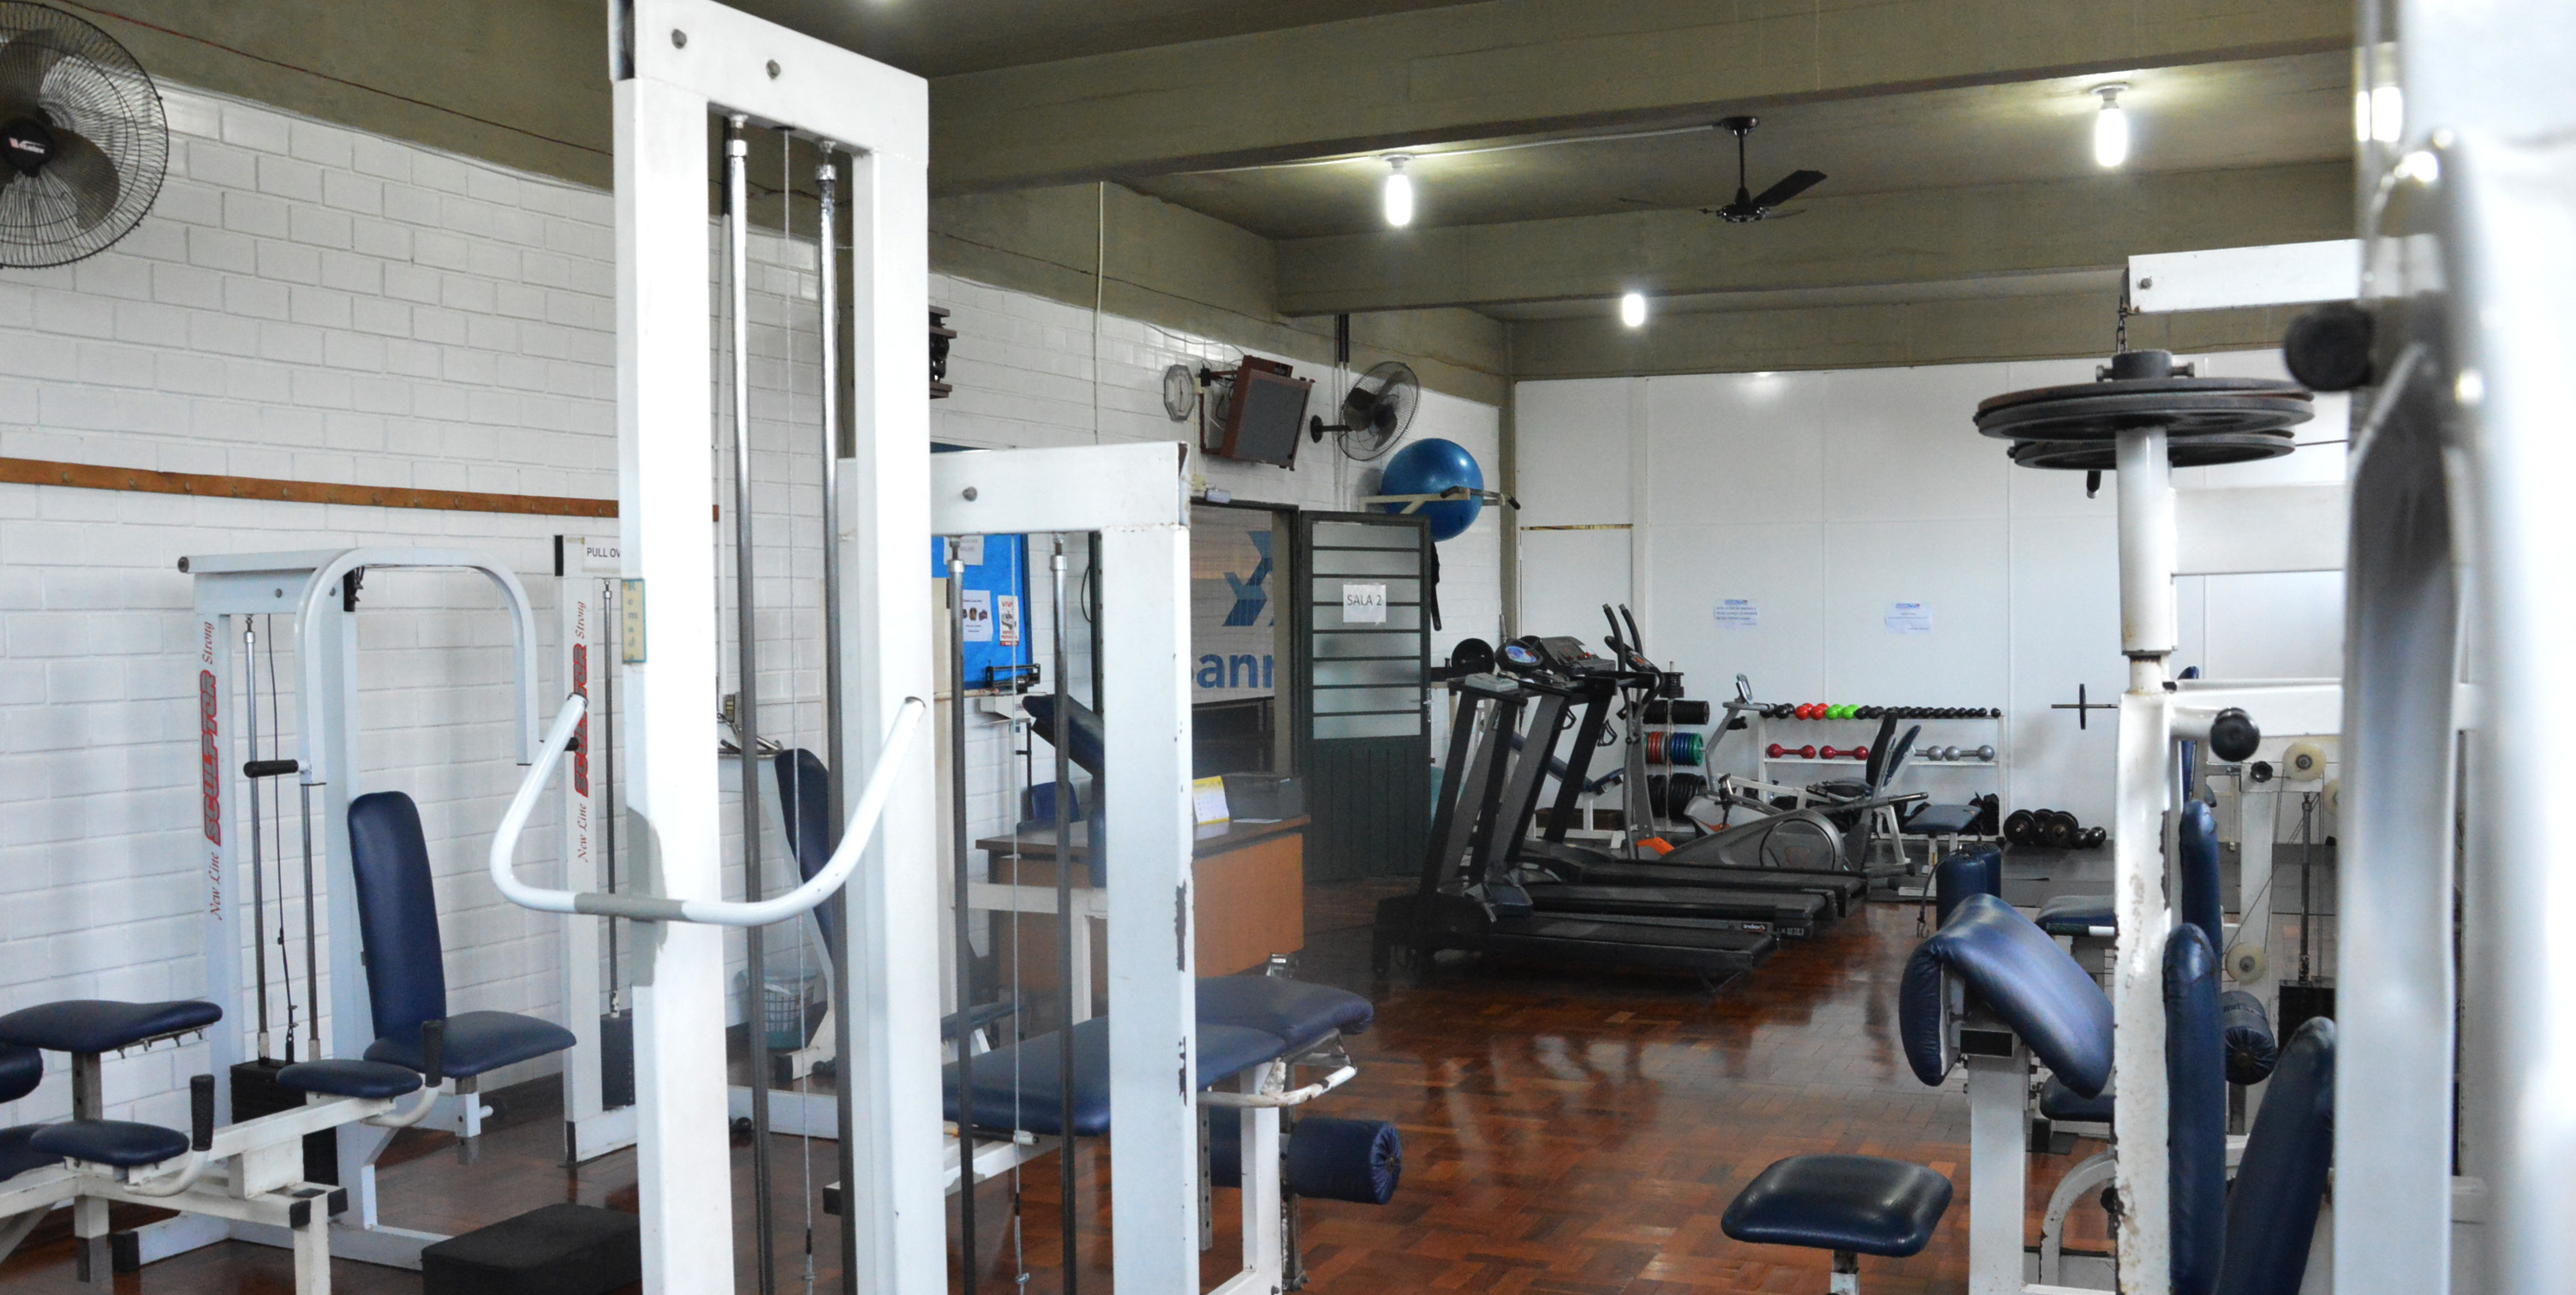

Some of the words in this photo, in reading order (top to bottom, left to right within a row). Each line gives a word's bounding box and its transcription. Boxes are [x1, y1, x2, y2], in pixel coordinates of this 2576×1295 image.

[587, 547, 607, 557] PULL
[1346, 594, 1373, 606] SALA
[1376, 594, 1382, 606] 2
[575, 601, 587, 639] Strong
[202, 621, 214, 665] Strong
[1191, 653, 1273, 689] an
[573, 643, 588, 798] SCULTOR
[200, 669, 221, 847] SCULPTOR
[577, 803, 587, 831] Line
[577, 834, 588, 862] New
[209, 852, 220, 883] Line
[210, 886, 223, 921] New
